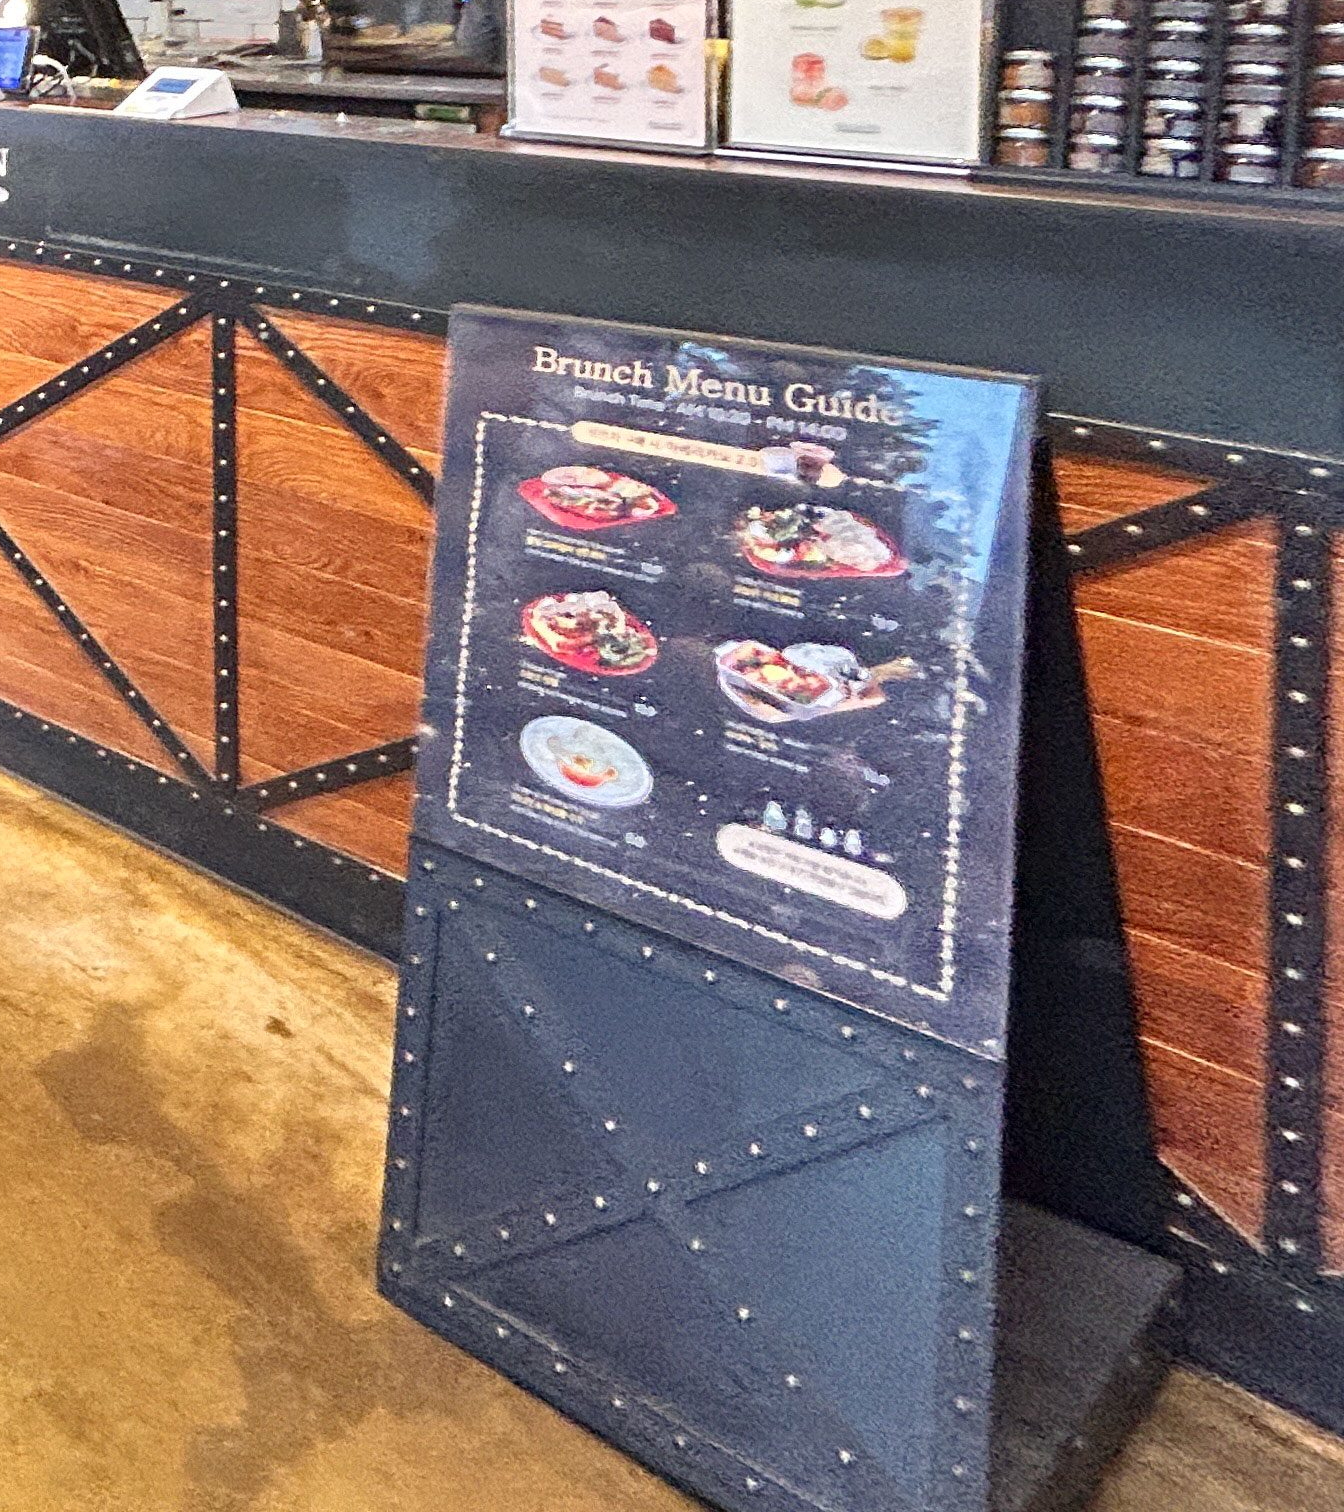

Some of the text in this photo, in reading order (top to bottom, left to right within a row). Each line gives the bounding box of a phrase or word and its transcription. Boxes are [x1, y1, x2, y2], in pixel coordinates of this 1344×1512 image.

[533, 345, 904, 426] Brunch Menu Guide
